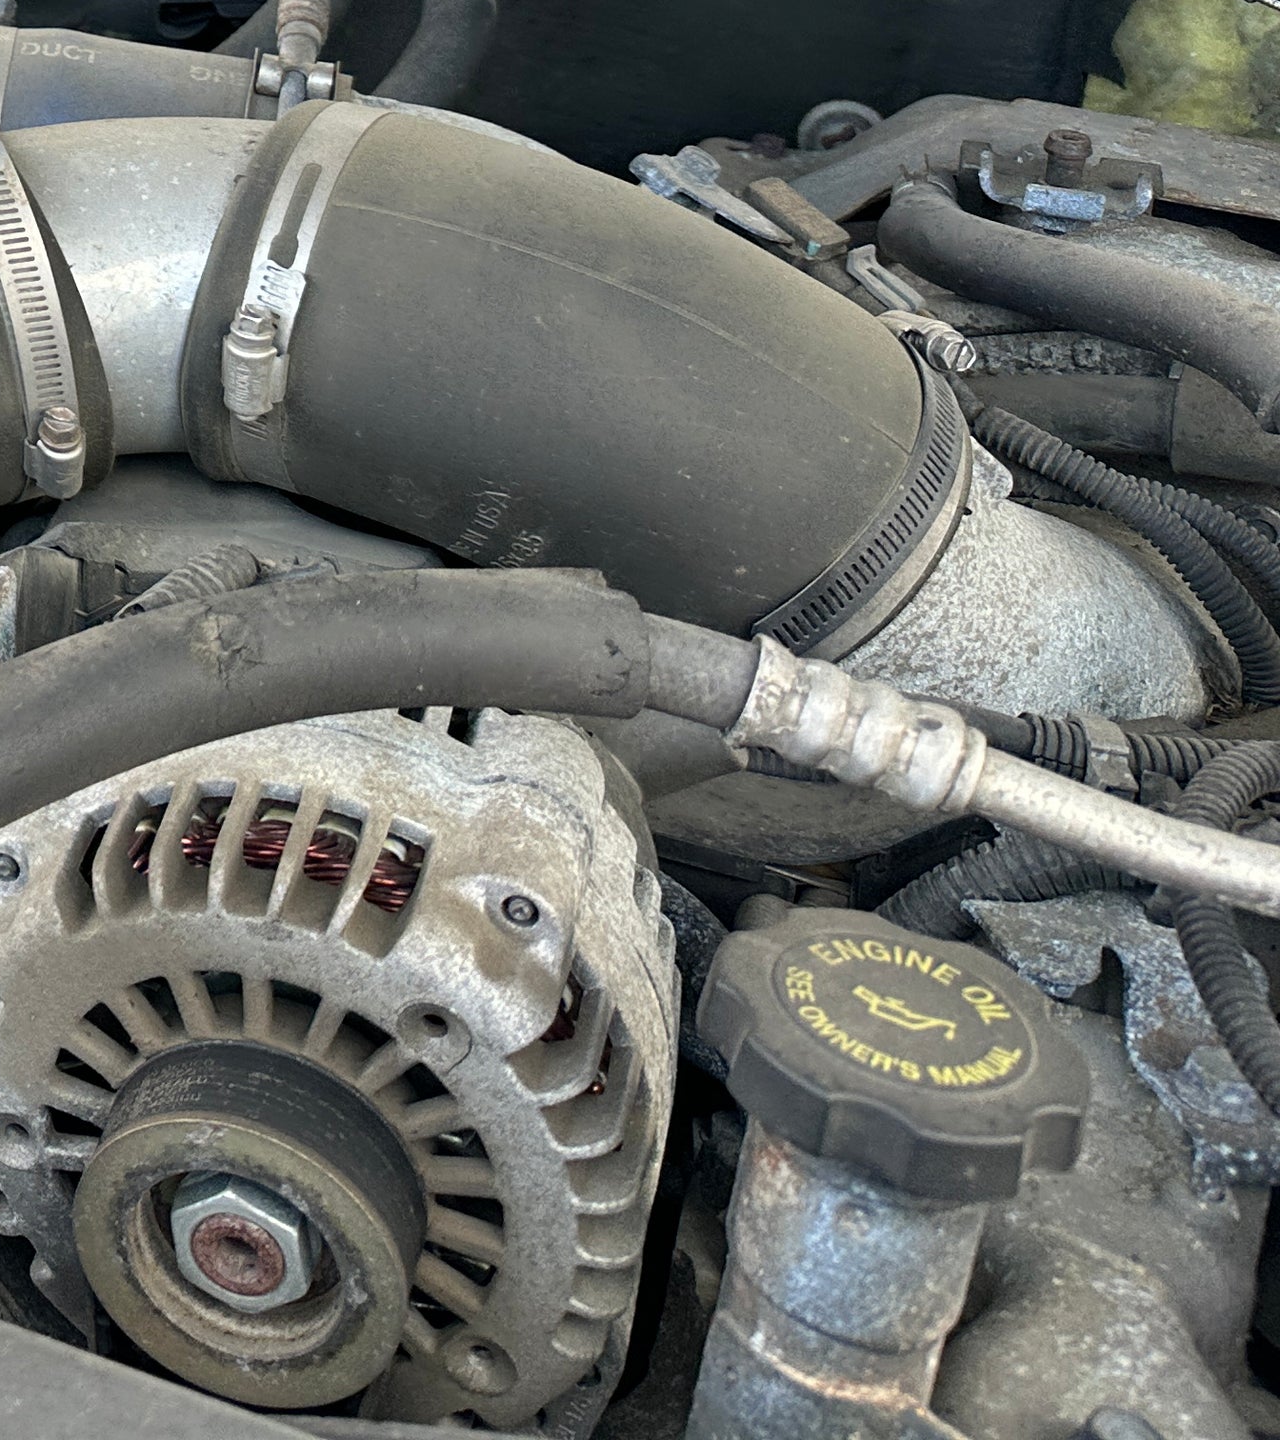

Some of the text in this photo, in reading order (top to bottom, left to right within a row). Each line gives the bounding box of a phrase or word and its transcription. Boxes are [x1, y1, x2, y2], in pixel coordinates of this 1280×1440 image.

[785, 966, 1022, 1086] SEE OWNER'S MANUAL
[808, 939, 1011, 1025] ENGINE OIL
